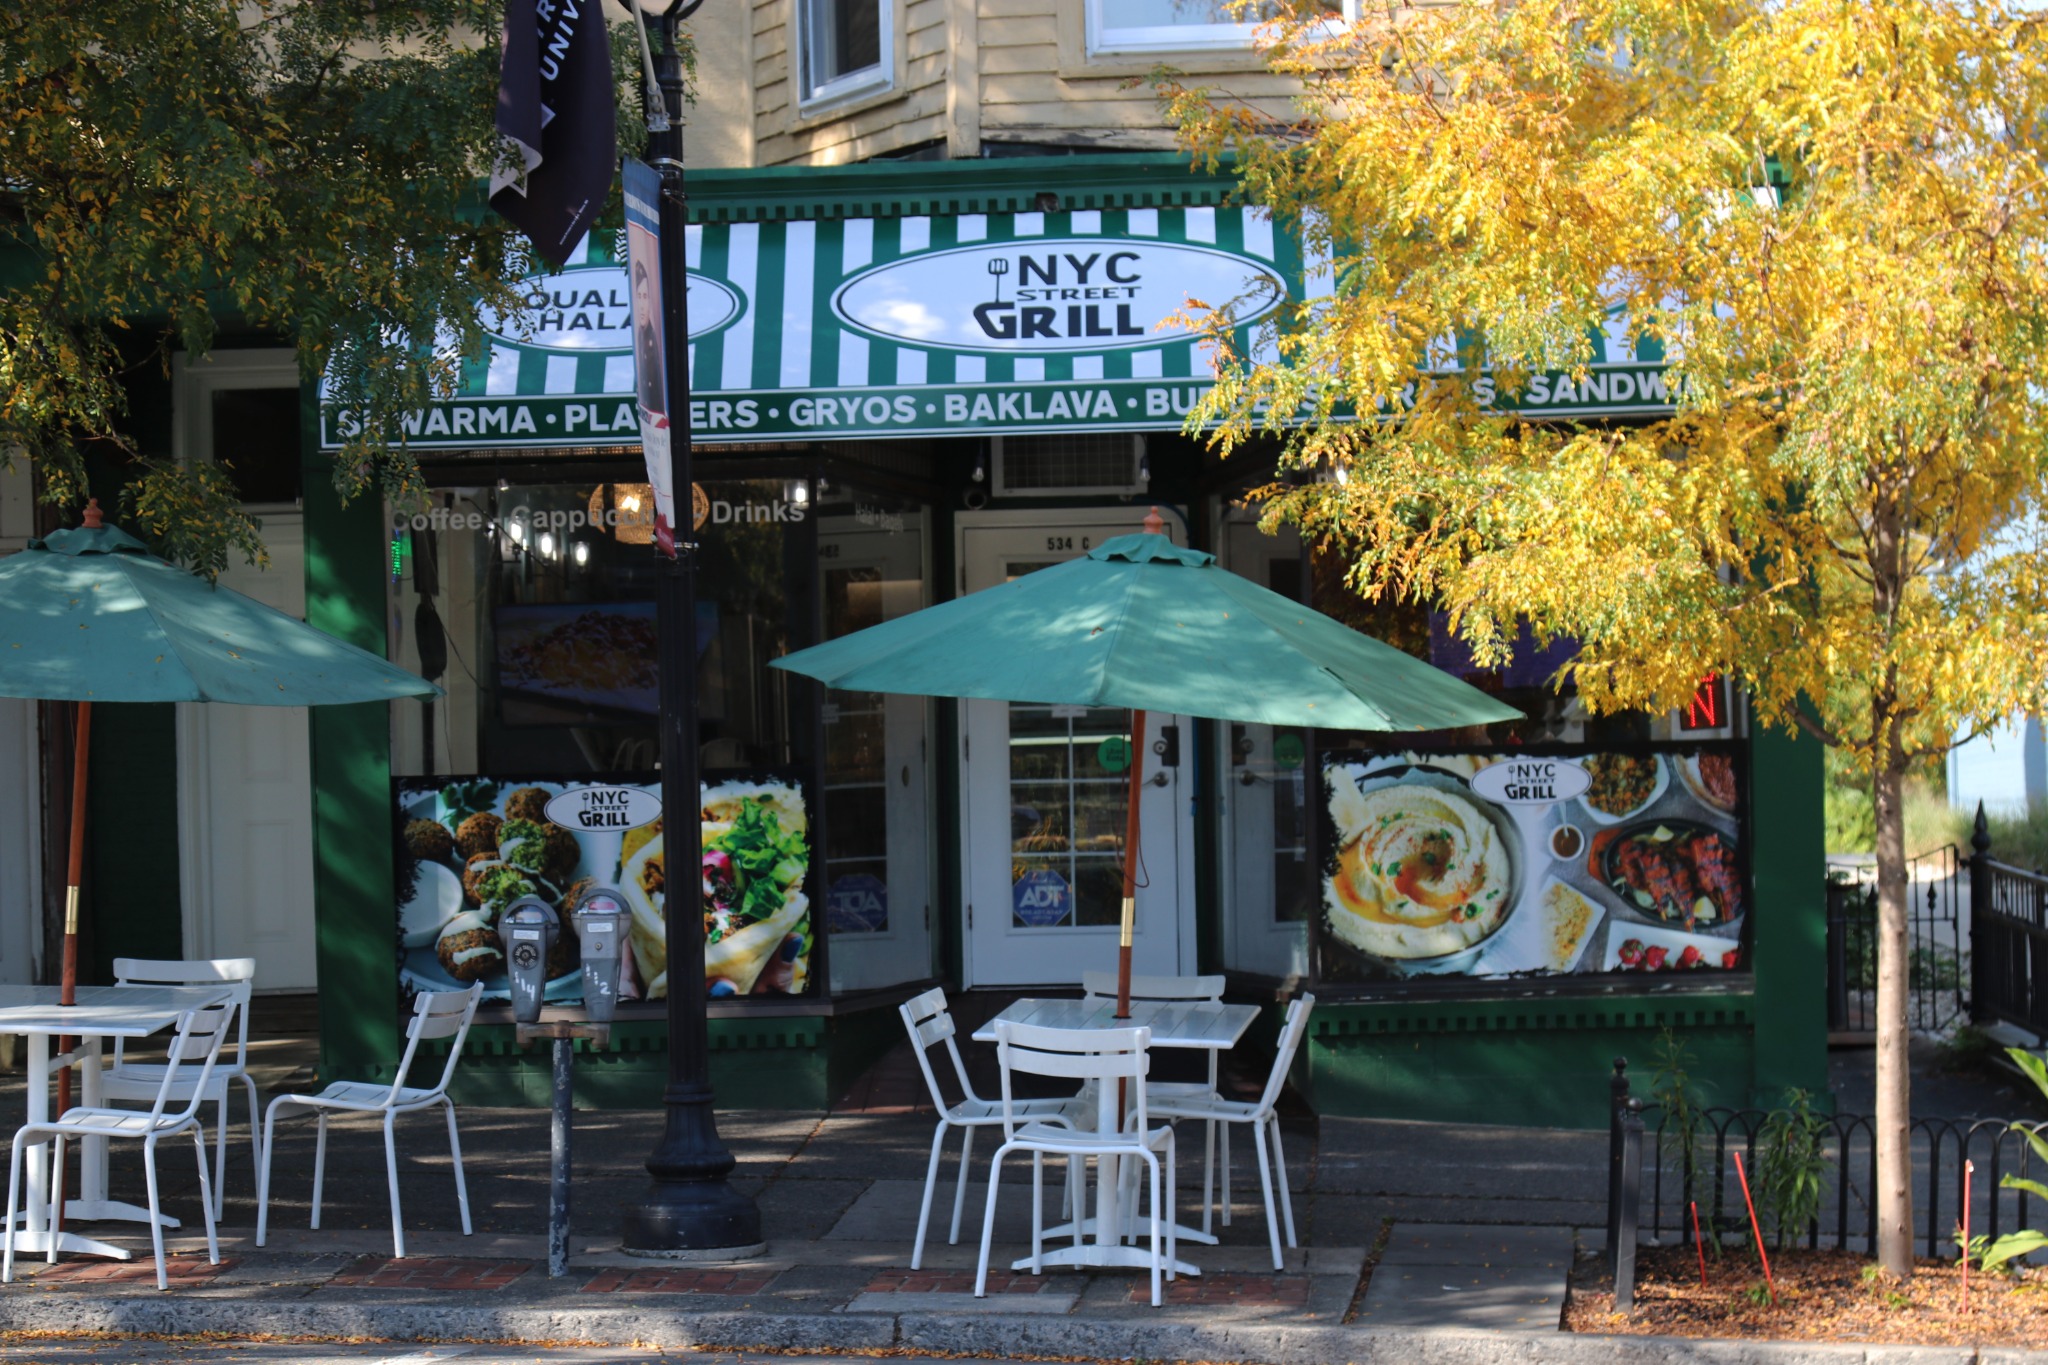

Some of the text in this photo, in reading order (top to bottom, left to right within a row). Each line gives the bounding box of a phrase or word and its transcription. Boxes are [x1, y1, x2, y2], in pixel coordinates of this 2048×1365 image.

[540, 0, 585, 81] UNIV
[1019, 252, 1142, 286] NYC
[1016, 286, 1142, 301] STREET
[973, 301, 1144, 339] GRILL
[336, 405, 537, 437] SWARMA
[565, 400, 759, 432] PLAERS
[789, 395, 917, 426] GRYOS
[944, 389, 1118, 422] BAKLAVA
[391, 507, 482, 532] Coffee
[712, 500, 805, 524] Drinks
[1047, 536, 1072, 550] 534
[1517, 763, 1556, 778] NYC
[591, 790, 630, 805] NYC
[1504, 783, 1557, 800] GRILL
[578, 810, 630, 827] GRILL
[1019, 885, 1065, 908] ADT
